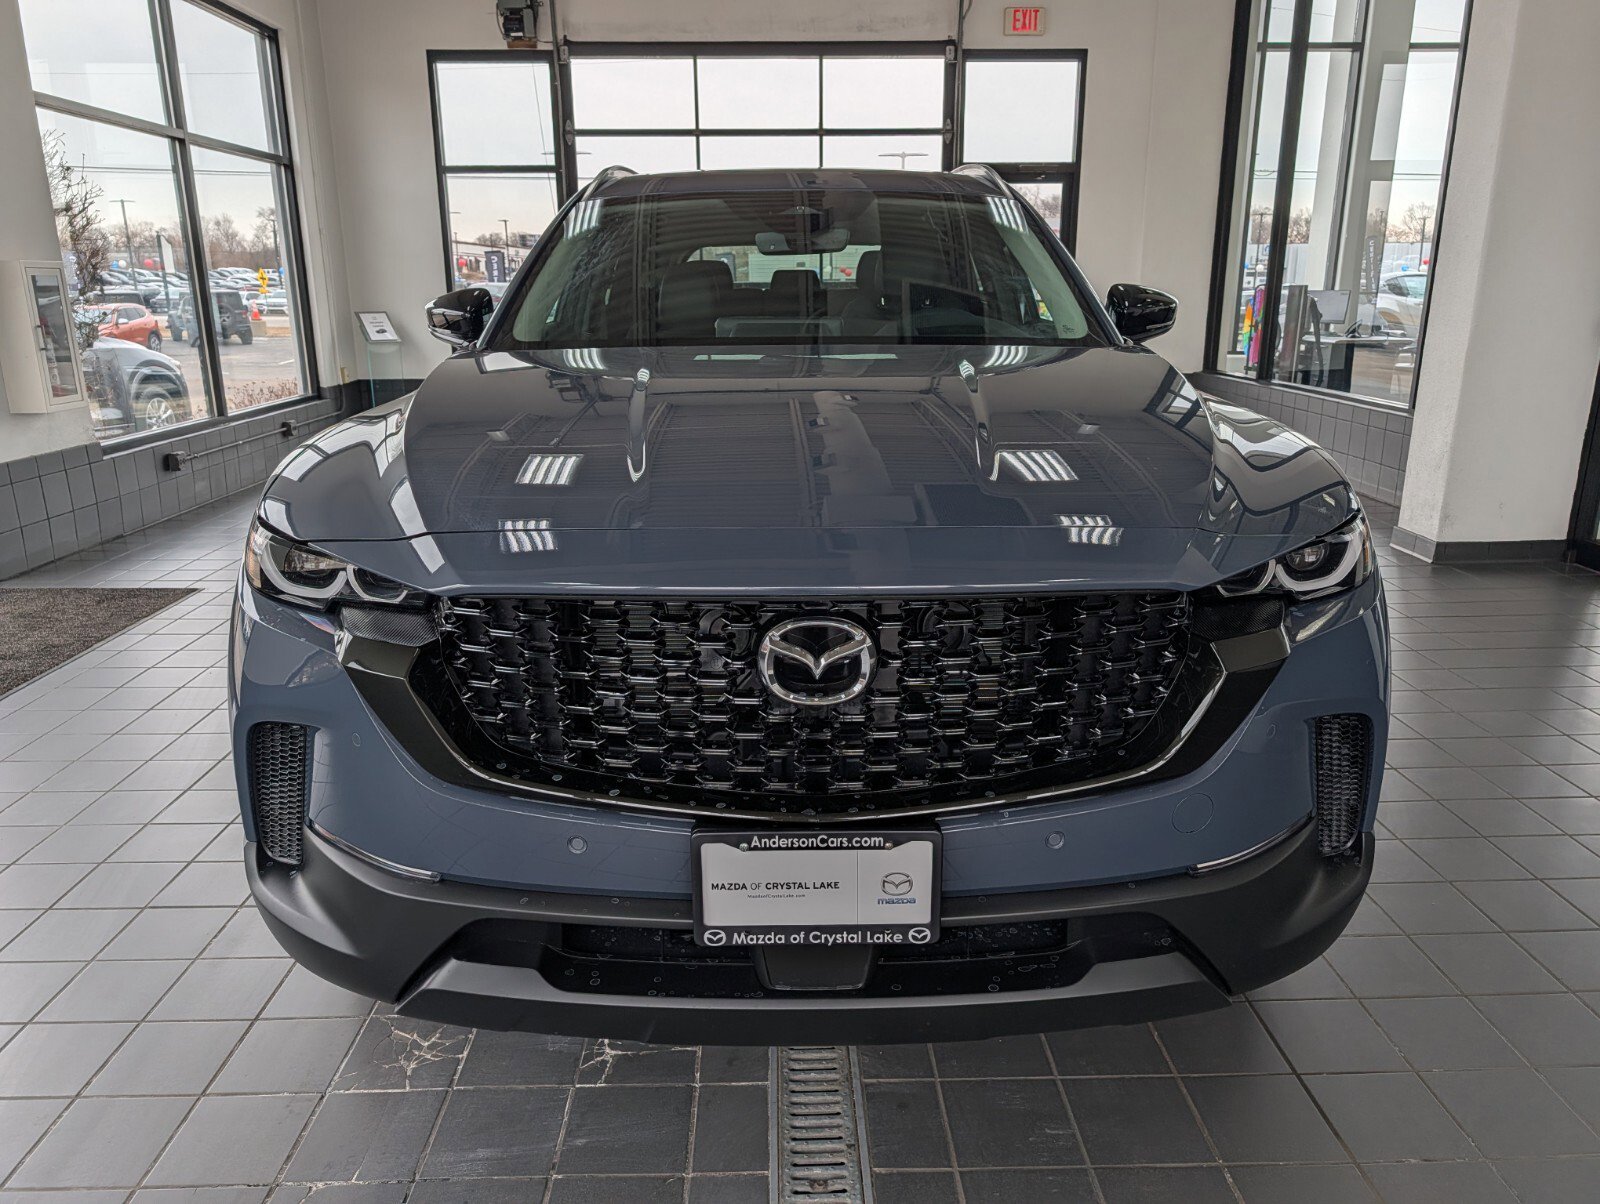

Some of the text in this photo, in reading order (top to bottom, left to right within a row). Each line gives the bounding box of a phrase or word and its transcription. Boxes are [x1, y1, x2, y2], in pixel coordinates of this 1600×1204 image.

[1012, 9, 1040, 31] EXIT
[750, 835, 884, 848] AndersonCars.com
[711, 881, 840, 891] MAZDA OF CRYSTAL LAKE
[877, 897, 917, 905] mazda
[732, 930, 903, 946] Mazda of Crystal Lake
